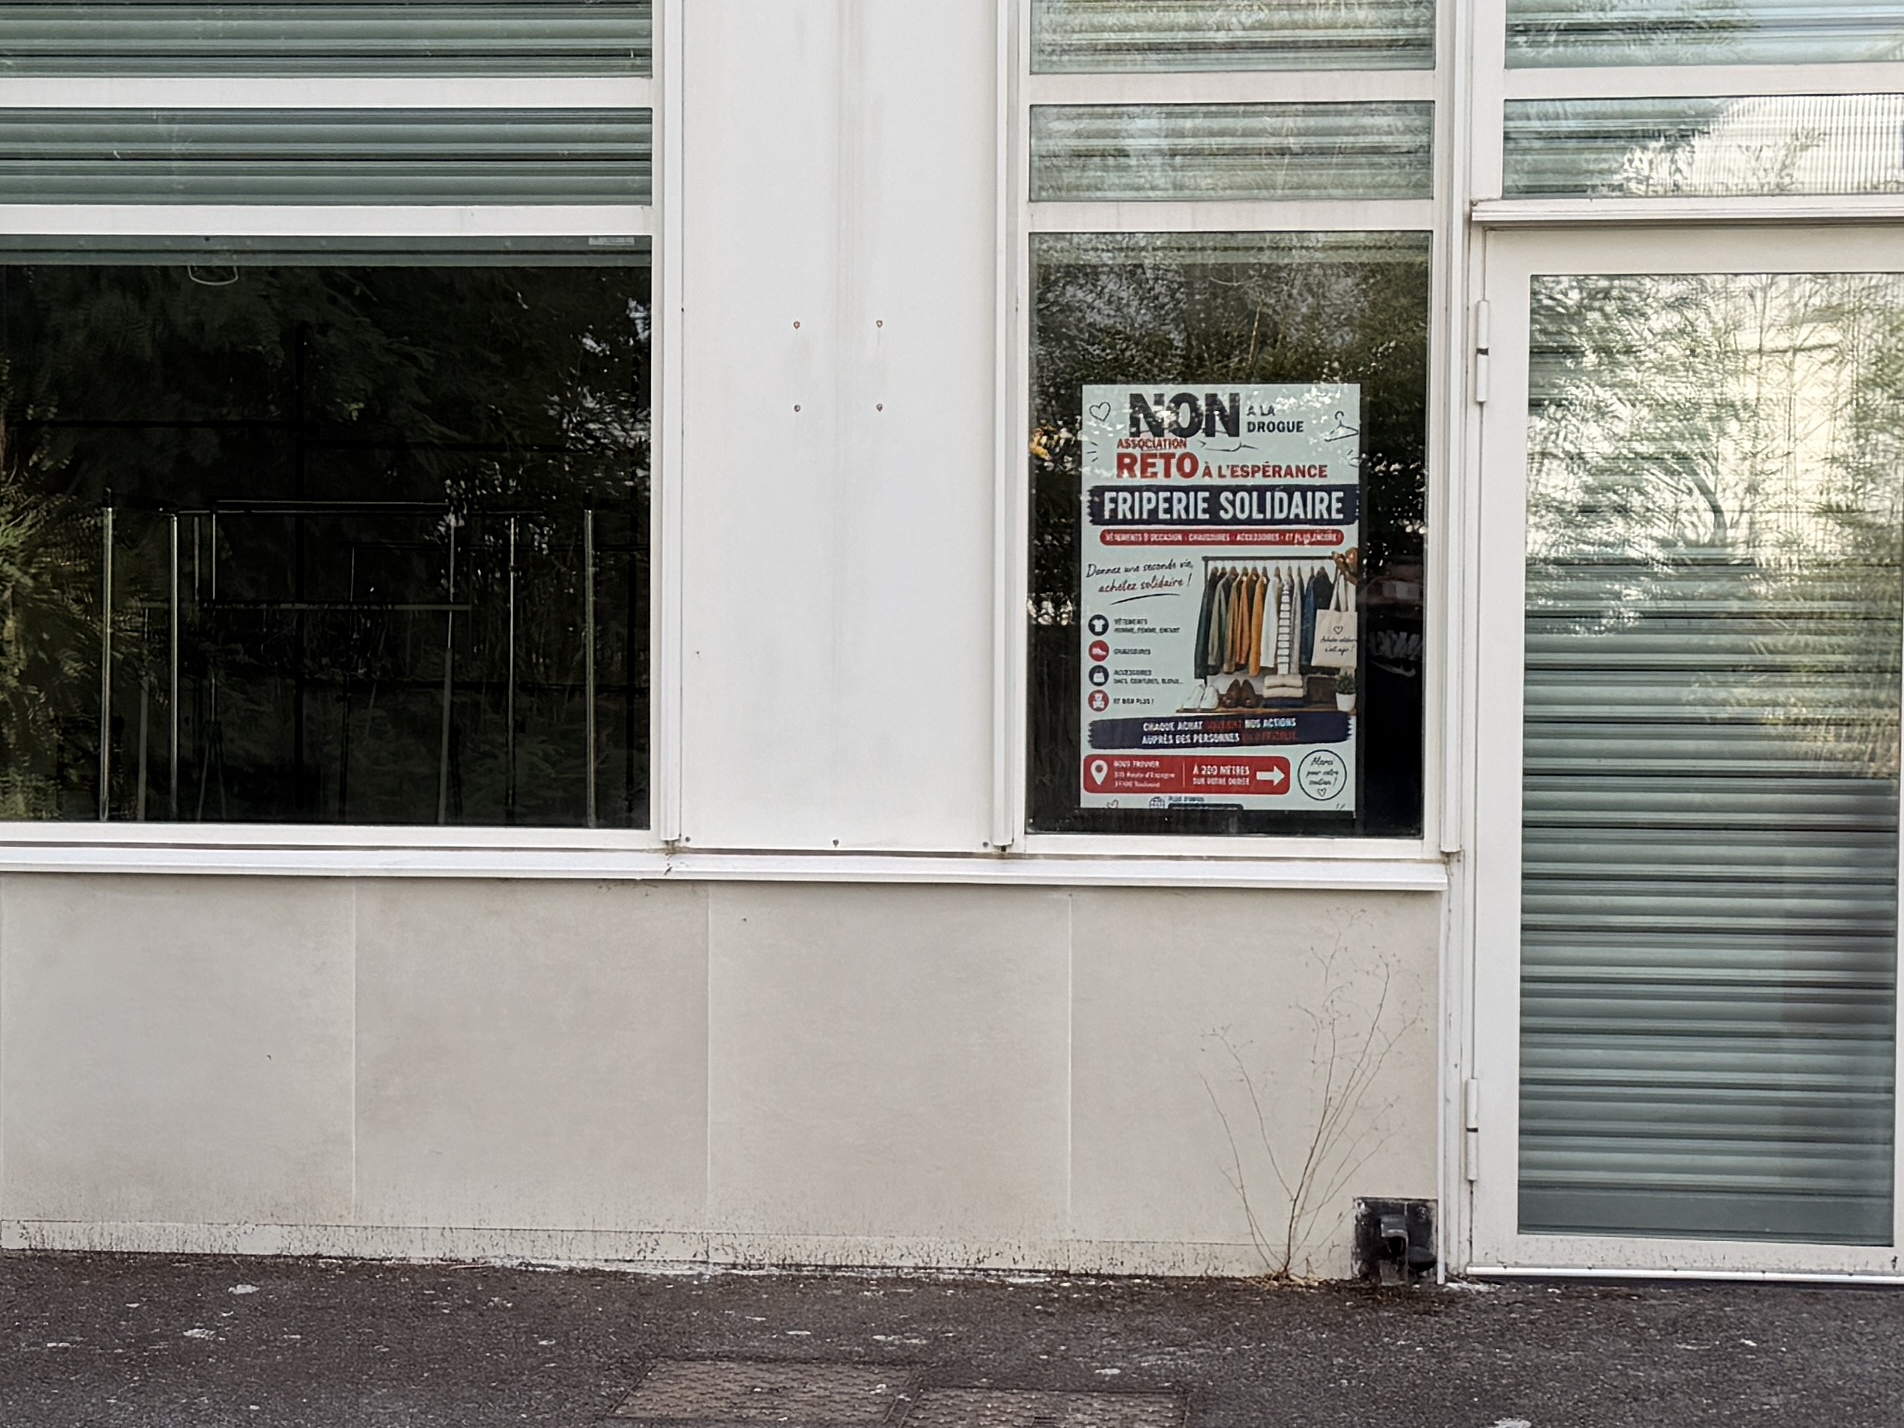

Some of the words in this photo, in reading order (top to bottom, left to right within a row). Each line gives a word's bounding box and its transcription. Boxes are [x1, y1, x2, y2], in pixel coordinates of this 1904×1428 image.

[1129, 392, 1240, 438] NON
[1260, 405, 1275, 417] LA
[1247, 420, 1304, 433] DROGUE
[1116, 438, 1187, 450] ASSOCIATION
[1116, 452, 1199, 479] RETO
[1201, 461, 1213, 478] À
[1217, 461, 1328, 478] L'ESPÉRANCE
[1103, 491, 1210, 520] FRIPERIE
[1219, 491, 1344, 520] SOLIDAIRE
[1085, 563, 1121, 578] Donnez
[1124, 565, 1140, 573] une
[1143, 558, 1177, 572] seconde
[1098, 578, 1137, 593] achetez
[1140, 574, 1184, 590] solidaire
[1143, 721, 1175, 732] CHAQUE
[1177, 720, 1203, 731] ACHAT
[1244, 719, 1261, 729] NOS
[1263, 717, 1297, 728] ACTIONS
[1142, 733, 1174, 745] AUPRÈS
[1175, 733, 1191, 744] DES
[1193, 732, 1240, 743] PERSONNES
[1219, 765, 1250, 776] MÈTRES
